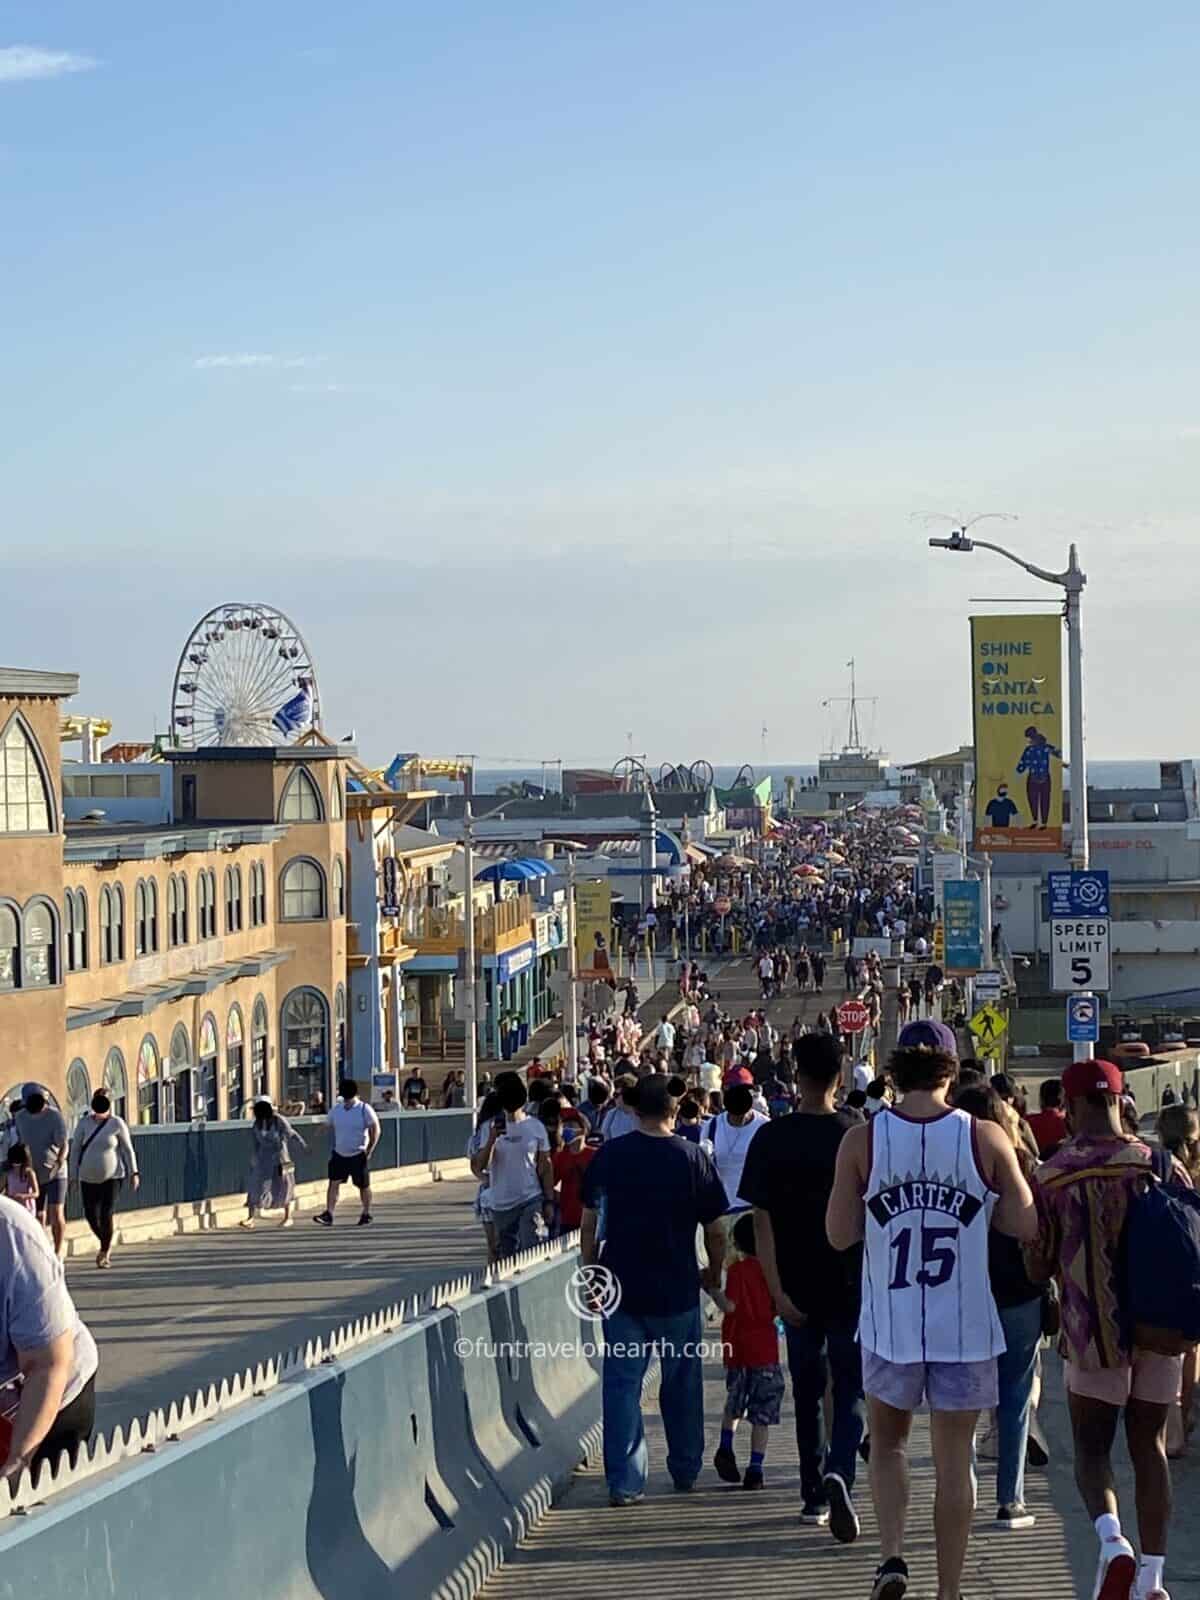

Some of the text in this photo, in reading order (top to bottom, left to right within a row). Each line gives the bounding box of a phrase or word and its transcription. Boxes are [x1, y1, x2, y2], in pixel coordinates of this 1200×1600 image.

[980, 642, 1033, 656] SHINE
[981, 662, 1009, 676] ON
[981, 681, 1038, 696] SANTA
[981, 701, 1055, 716] MONICA
[1054, 924, 1107, 936] SPEED
[1059, 941, 1102, 953] LIMIT
[1071, 958, 1092, 985] 5
[841, 1010, 866, 1022] STOP
[879, 1183, 967, 1217] CARTER
[887, 1227, 959, 1290] 15
